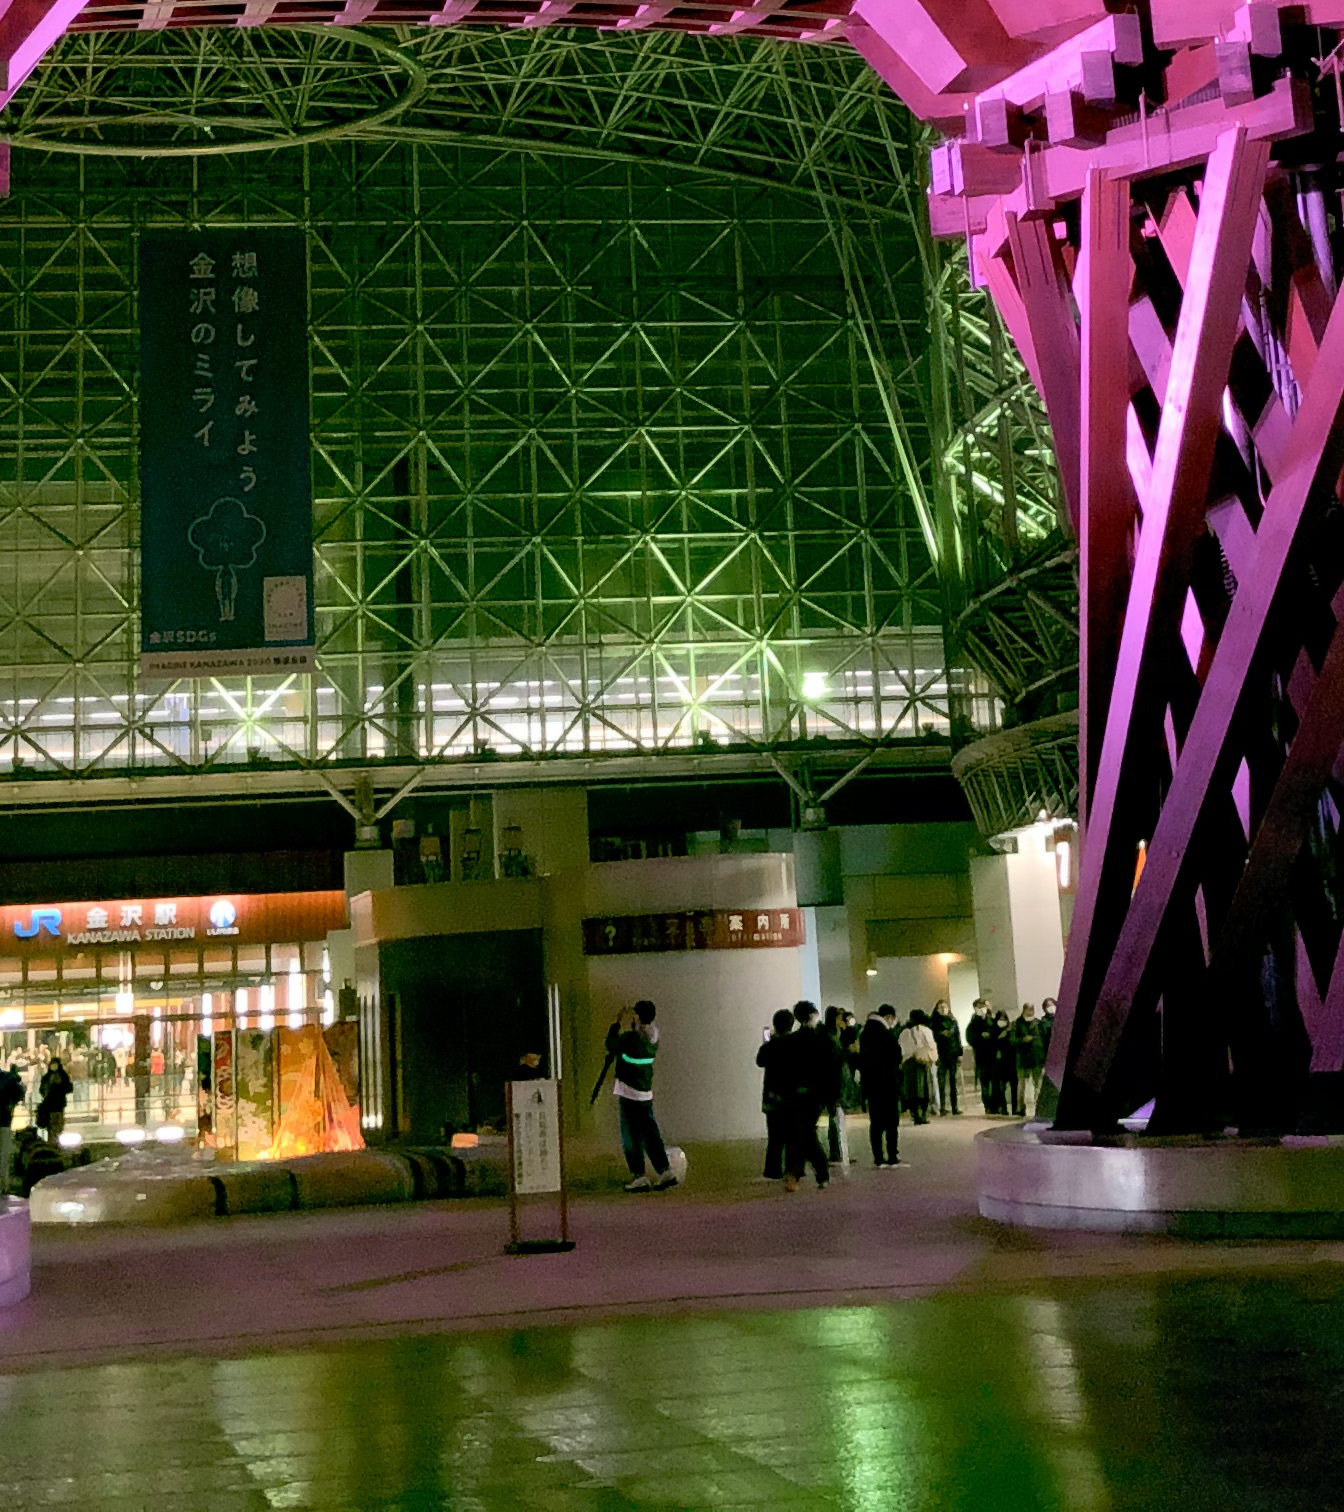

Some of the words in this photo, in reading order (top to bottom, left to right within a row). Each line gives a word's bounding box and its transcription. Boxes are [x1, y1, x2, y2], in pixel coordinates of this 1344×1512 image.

[189, 251, 216, 447] 金沢のミライ
[231, 251, 257, 492] 想像してみよう
[13, 908, 63, 937] JR
[86, 903, 177, 929] 金沢駅
[67, 930, 142, 945] KANAZAWA
[145, 927, 196, 941] STATION
